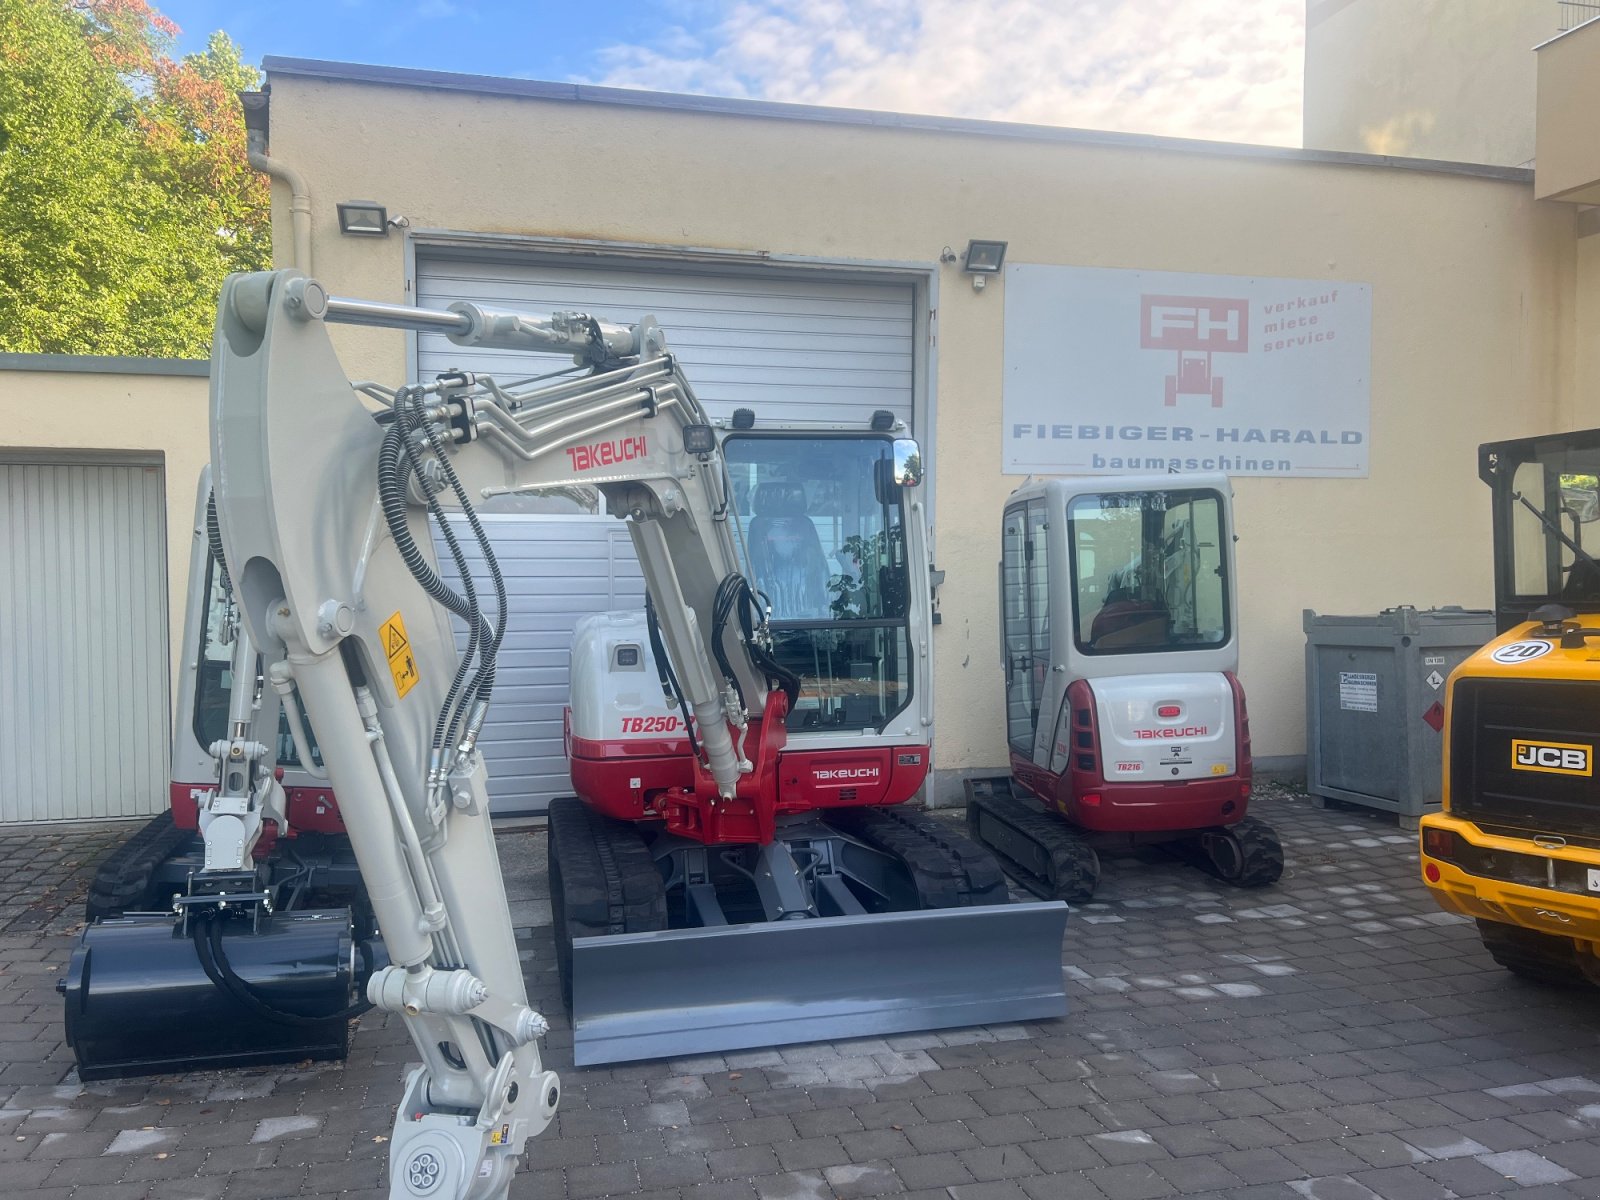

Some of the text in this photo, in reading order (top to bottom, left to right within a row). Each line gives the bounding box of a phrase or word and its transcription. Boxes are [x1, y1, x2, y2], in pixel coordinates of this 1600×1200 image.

[1263, 290, 1339, 314] verkauf
[1150, 306, 1239, 341] FH
[1264, 314, 1319, 333] miete
[1263, 330, 1336, 352] service
[566, 435, 647, 471] TAKEUCHI
[1092, 453, 1292, 471] baumaschinen
[1503, 644, 1542, 658] 20
[1133, 726, 1207, 739] TAKEUCHI
[1117, 762, 1141, 771] TB216
[1518, 746, 1586, 770] JCB
[812, 767, 879, 779] TAKEUCHI
